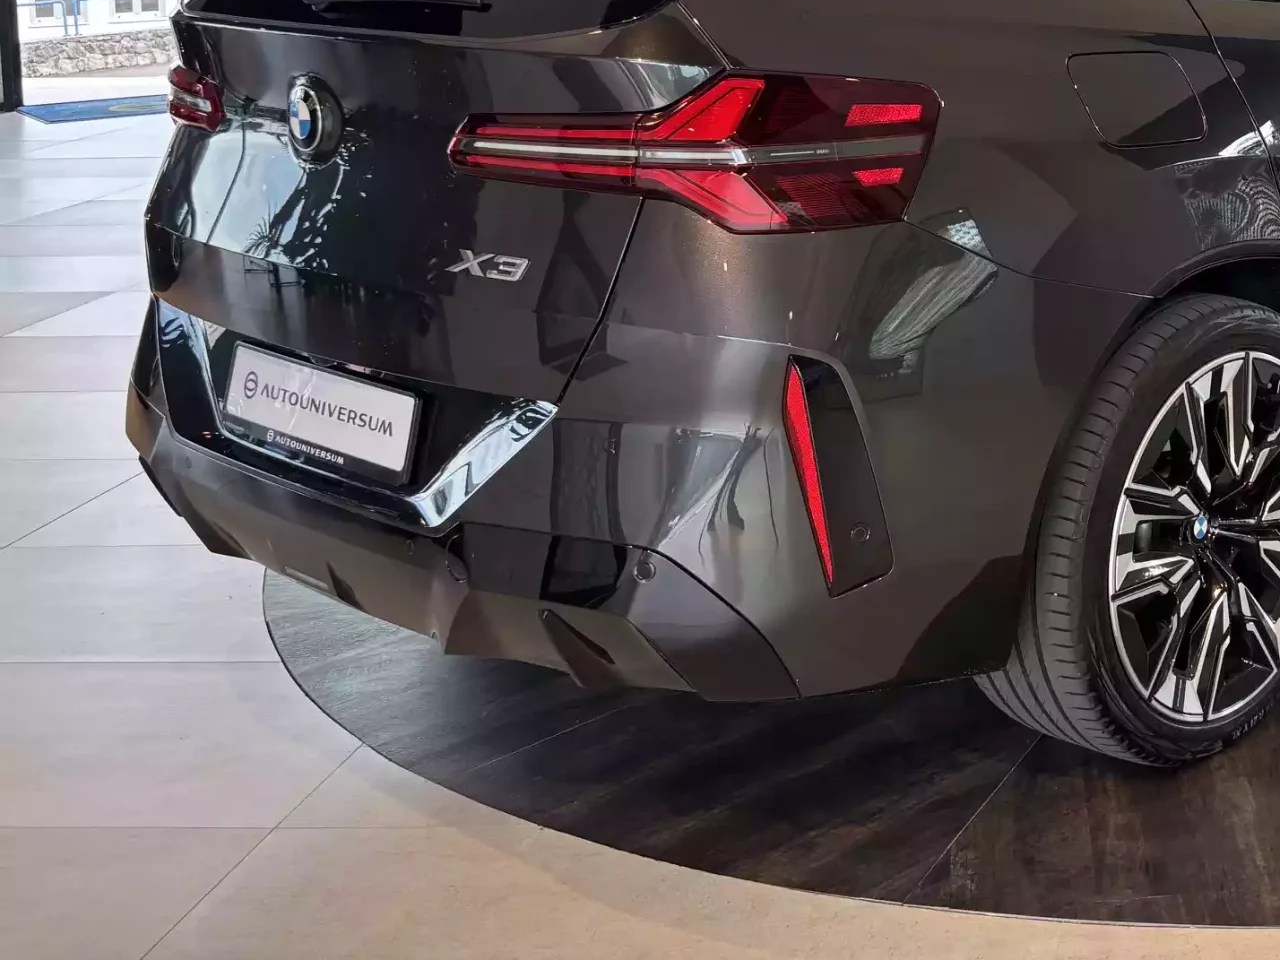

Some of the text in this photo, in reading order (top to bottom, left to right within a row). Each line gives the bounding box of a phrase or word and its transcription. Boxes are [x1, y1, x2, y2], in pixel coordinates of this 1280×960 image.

[444, 249, 530, 281] X3
[260, 382, 393, 437] AUTOUNIVERSUM
[275, 435, 344, 465] AUTOUNIVERSUM
